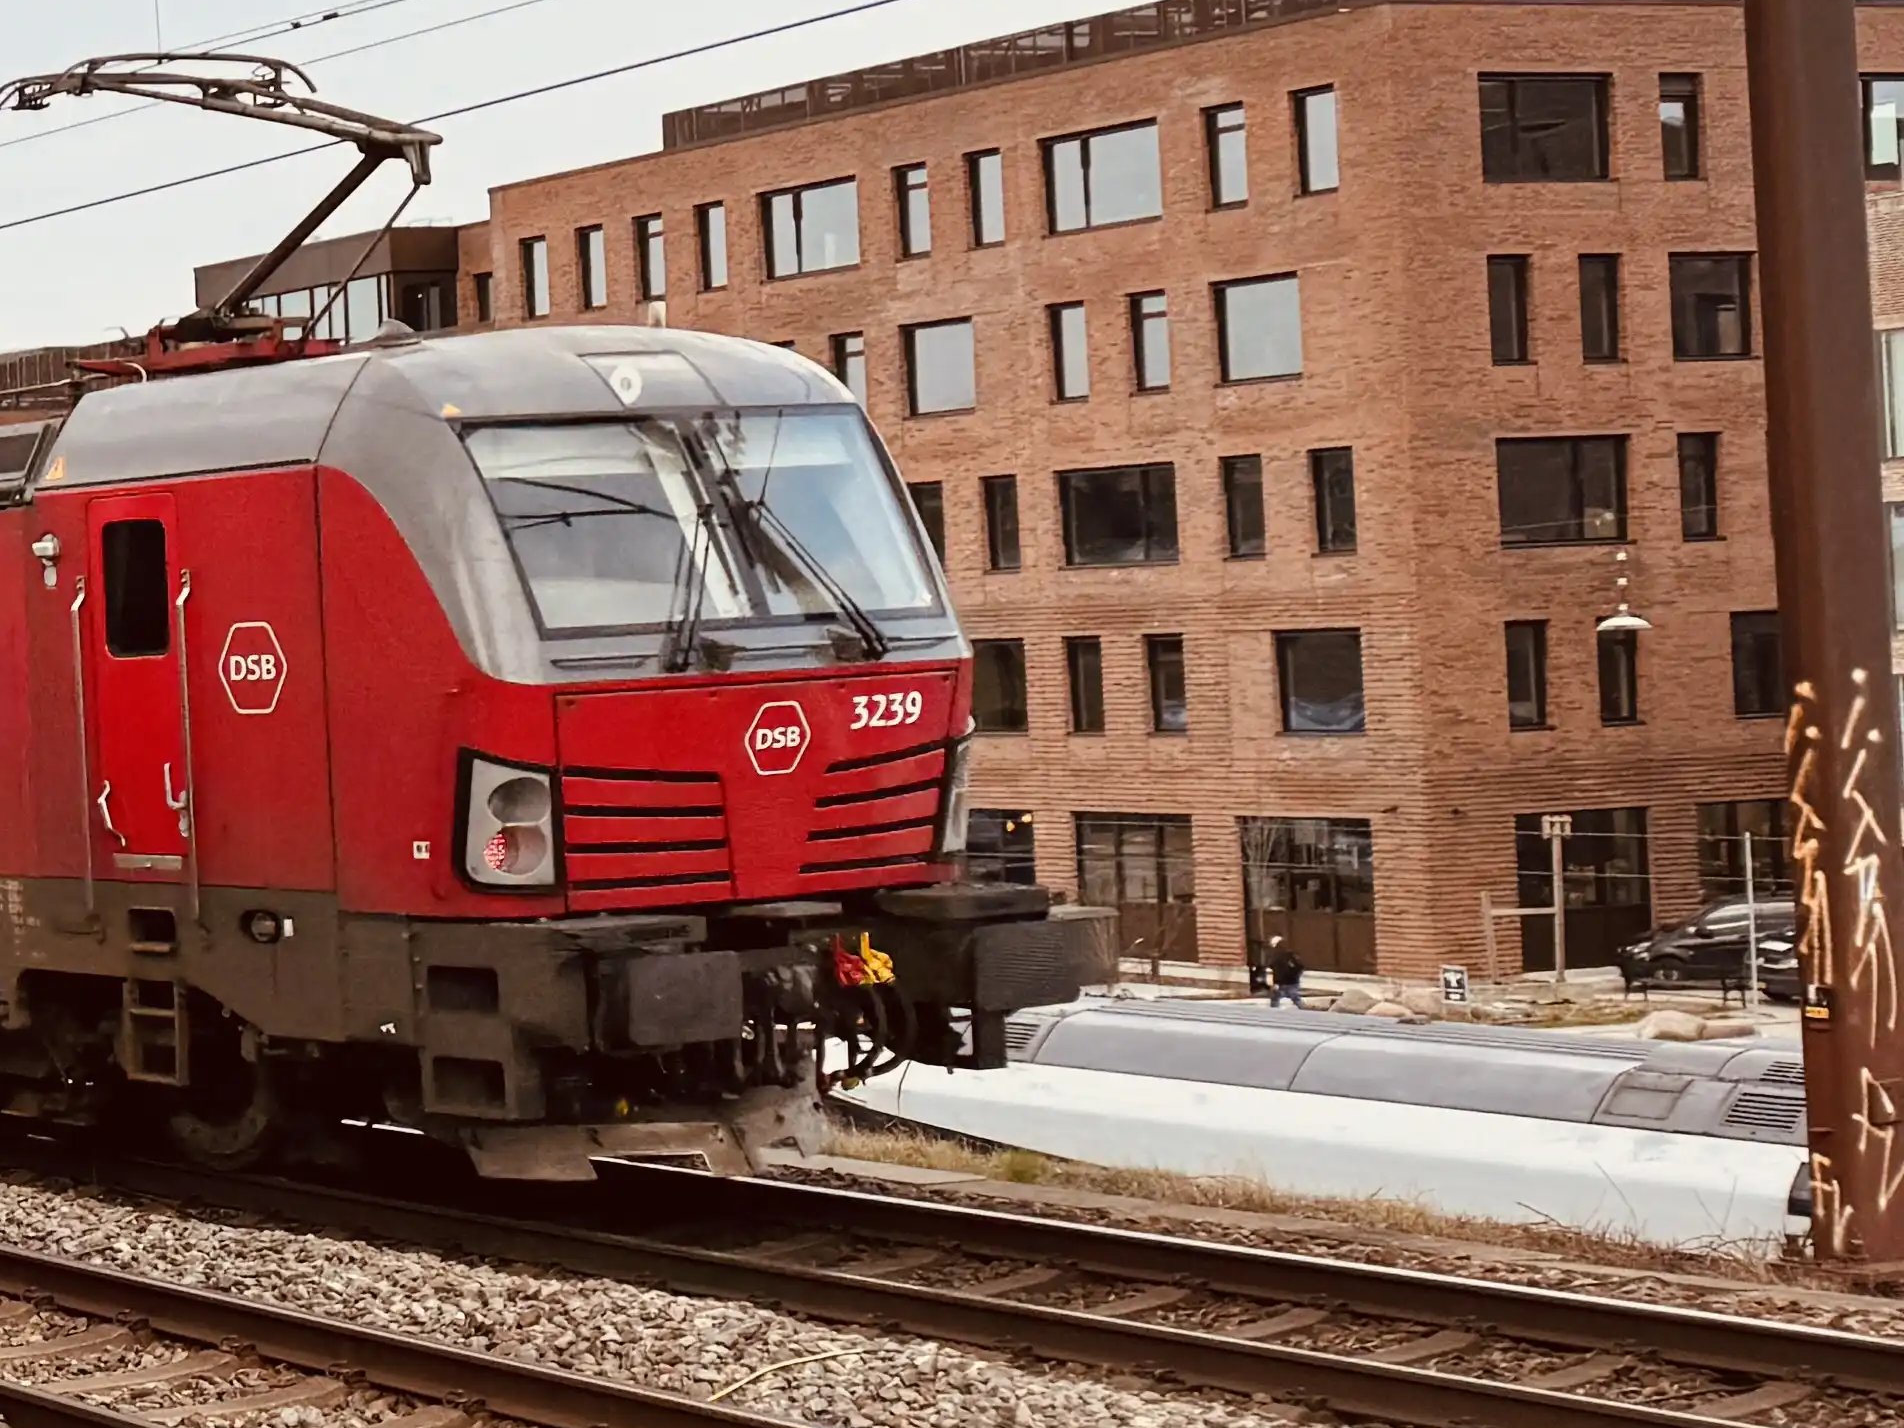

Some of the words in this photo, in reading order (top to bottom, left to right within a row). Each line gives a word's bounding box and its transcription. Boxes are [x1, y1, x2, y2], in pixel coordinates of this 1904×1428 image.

[229, 654, 277, 681] DSB
[850, 690, 923, 730] 3239
[755, 726, 801, 751] DSB
